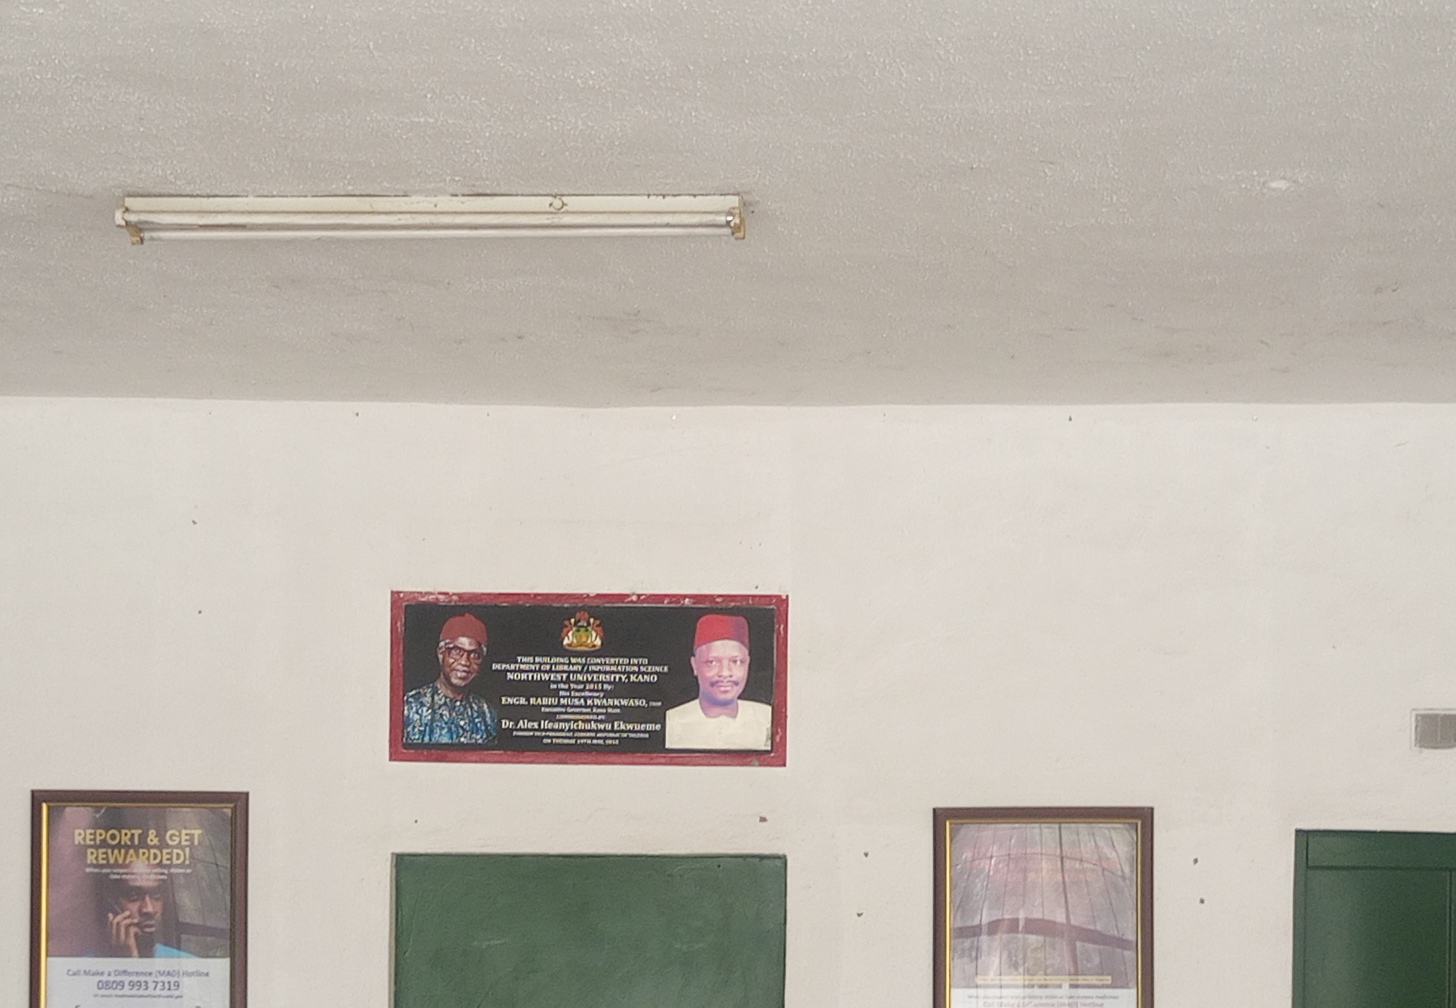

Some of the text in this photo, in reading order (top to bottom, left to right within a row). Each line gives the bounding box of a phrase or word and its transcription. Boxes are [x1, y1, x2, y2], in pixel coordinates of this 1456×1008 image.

[535, 656, 569, 664] BUILDING
[492, 663, 540, 671] DEPARTMENT
[506, 672, 657, 682] NORTHWEST UNIVERSITY, KANO
[501, 697, 528, 705] ENGR.
[529, 697, 558, 705] RABIU
[559, 697, 585, 705] MUSA
[586, 698, 648, 708] KWANKWASO,
[501, 719, 662, 731] Dr. Alex Ifeanyichukwu Ekwueme
[74, 829, 202, 846] REPORT & GET
[86, 848, 190, 865] REWARDED!
[182, 969, 209, 977] Hotline
[97, 980, 180, 991] 0809 993 7319
